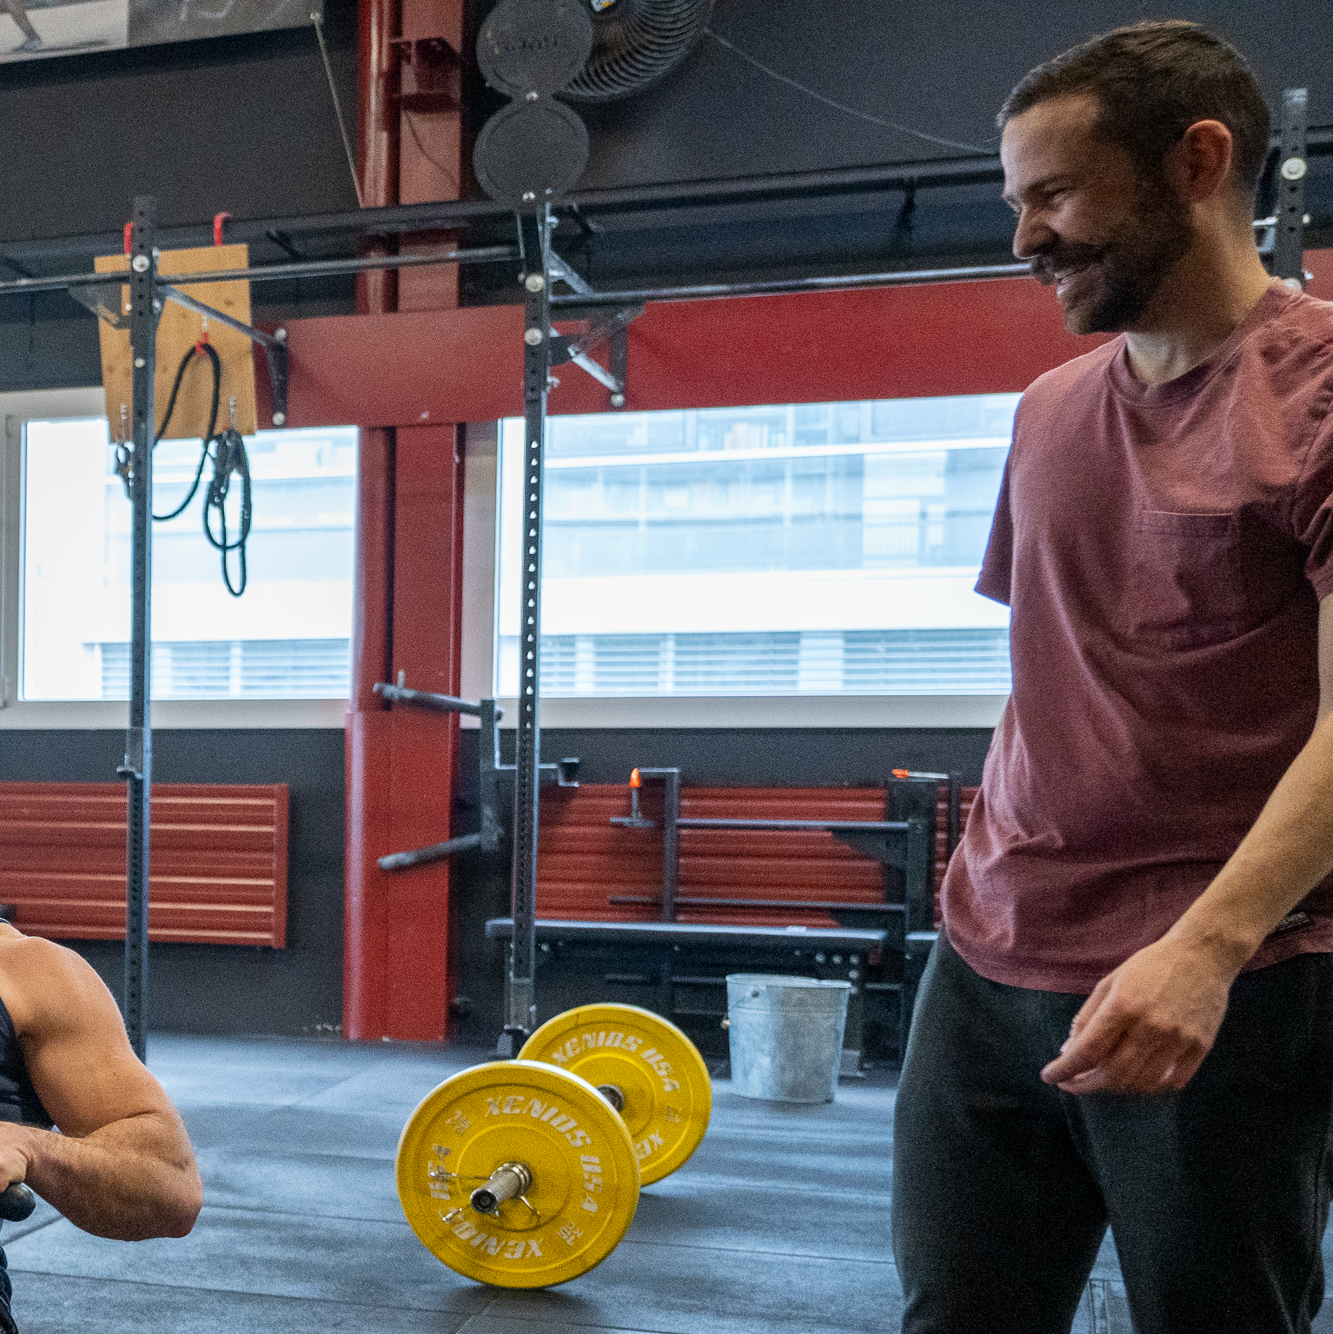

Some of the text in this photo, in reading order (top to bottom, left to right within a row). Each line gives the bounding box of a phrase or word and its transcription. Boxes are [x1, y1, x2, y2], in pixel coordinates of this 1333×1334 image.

[551, 1031, 643, 1067] XENIOS
[485, 1094, 603, 1213] XENIOS USA
